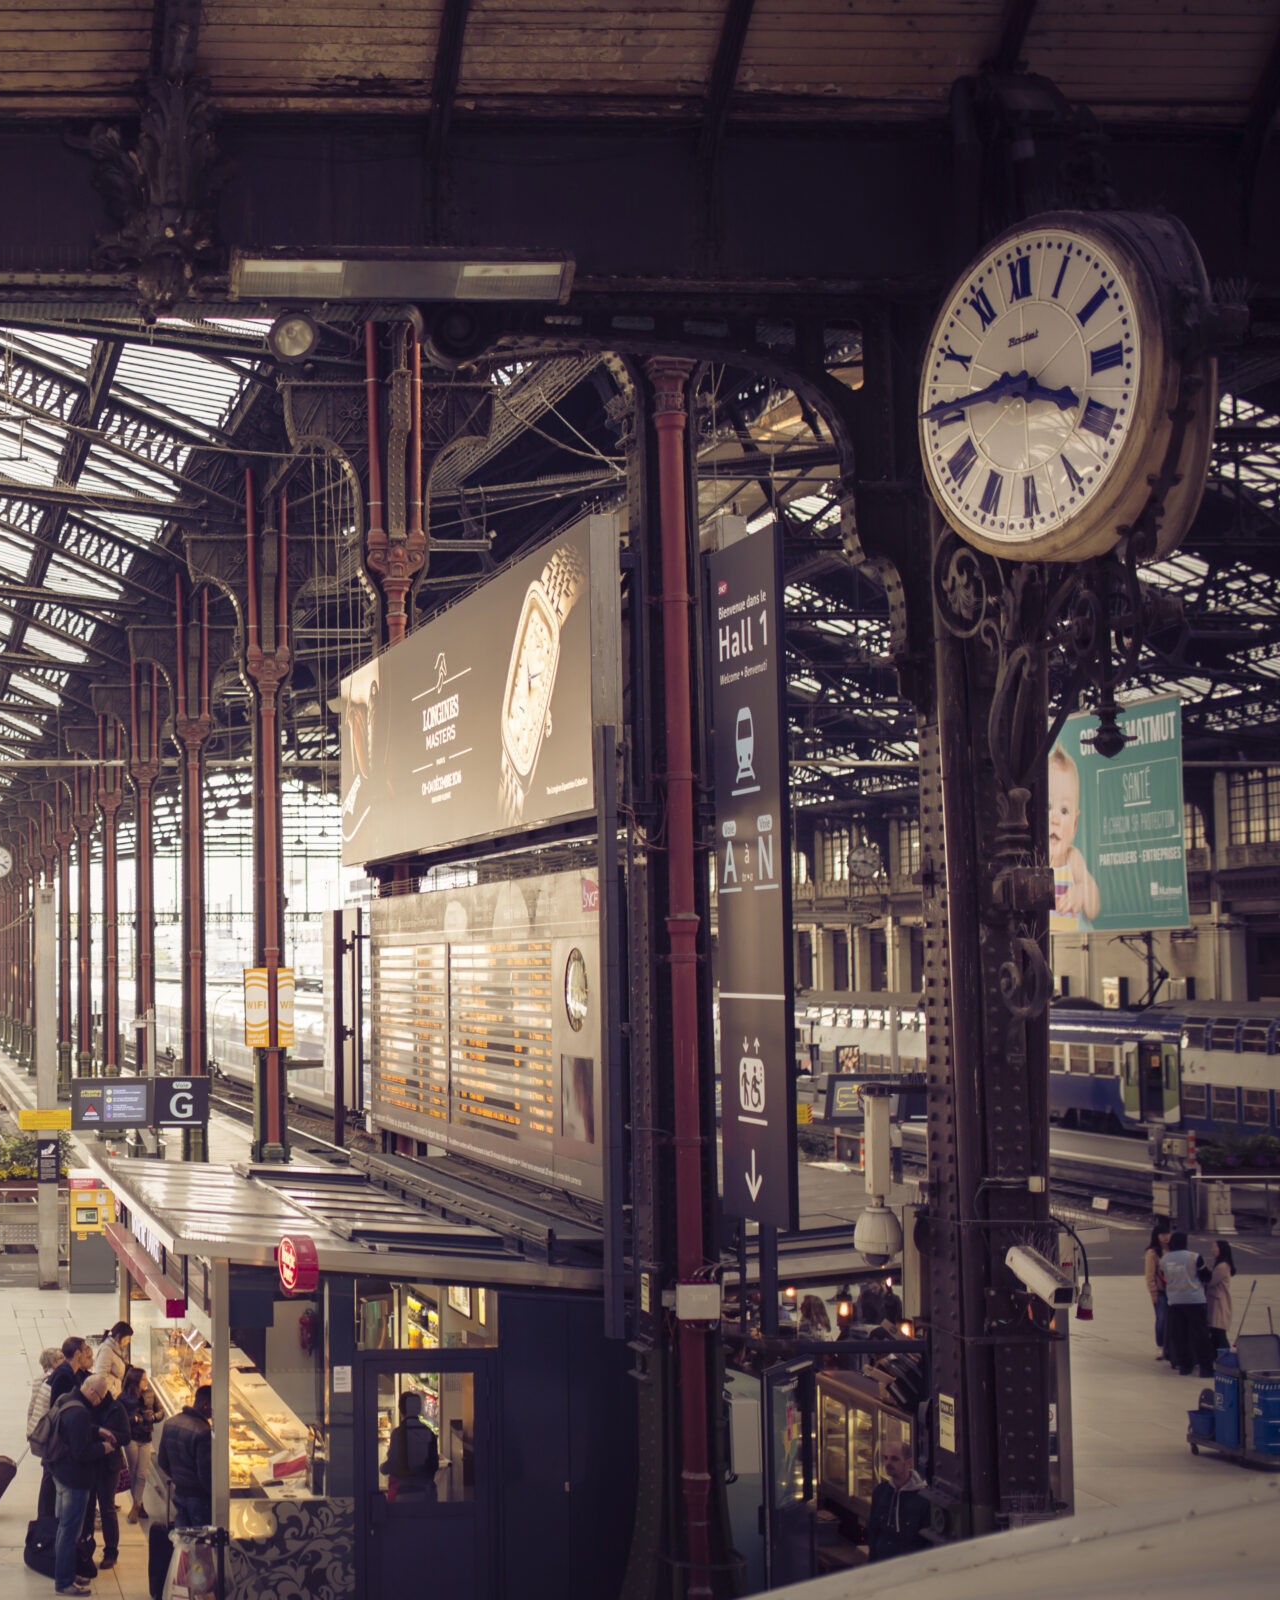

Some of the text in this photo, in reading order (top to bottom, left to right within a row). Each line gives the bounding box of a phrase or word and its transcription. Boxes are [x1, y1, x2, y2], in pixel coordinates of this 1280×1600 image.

[1008, 255, 1032, 304] XII
[718, 589, 767, 620] Bienvenue dans le
[719, 609, 768, 662] Hall 1
[720, 672, 741, 686] Welcome
[422, 694, 459, 732] LONGINES
[1124, 711, 1177, 748] MATMUT
[425, 724, 456, 751] MASTERS
[1122, 766, 1152, 802] SANTÉ
[723, 834, 774, 884] A à N
[1100, 846, 1182, 866] PARTICULIERS ENTREPRISES
[246, 1001, 267, 1011] WIFI
[169, 1092, 194, 1119] G
